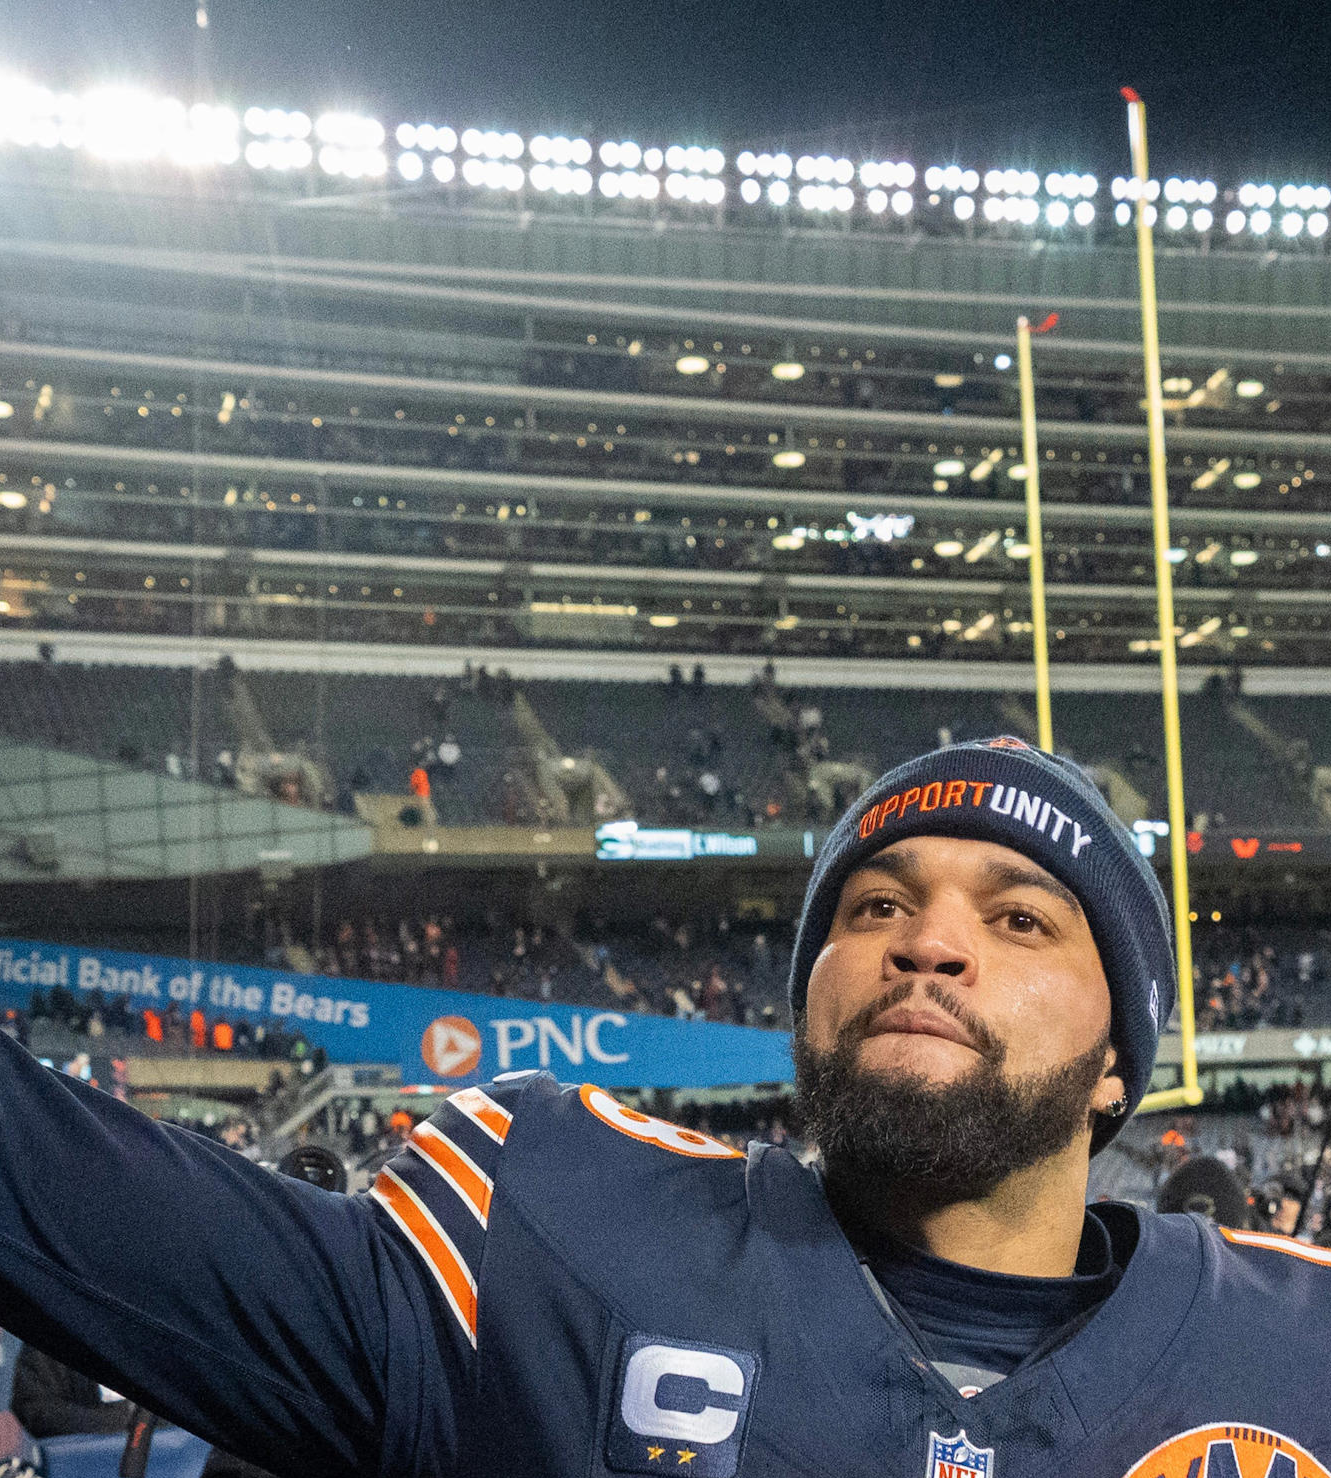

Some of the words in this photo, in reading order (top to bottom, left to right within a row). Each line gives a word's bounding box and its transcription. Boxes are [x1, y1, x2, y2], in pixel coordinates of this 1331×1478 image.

[858, 779, 1093, 859] OPPORTUNITY
[77, 957, 161, 998] Bank
[169, 971, 204, 1001] of
[208, 975, 264, 1011] the
[271, 982, 370, 1029] Bears
[488, 1011, 630, 1070] PNC
[621, 1344, 745, 1445] C
